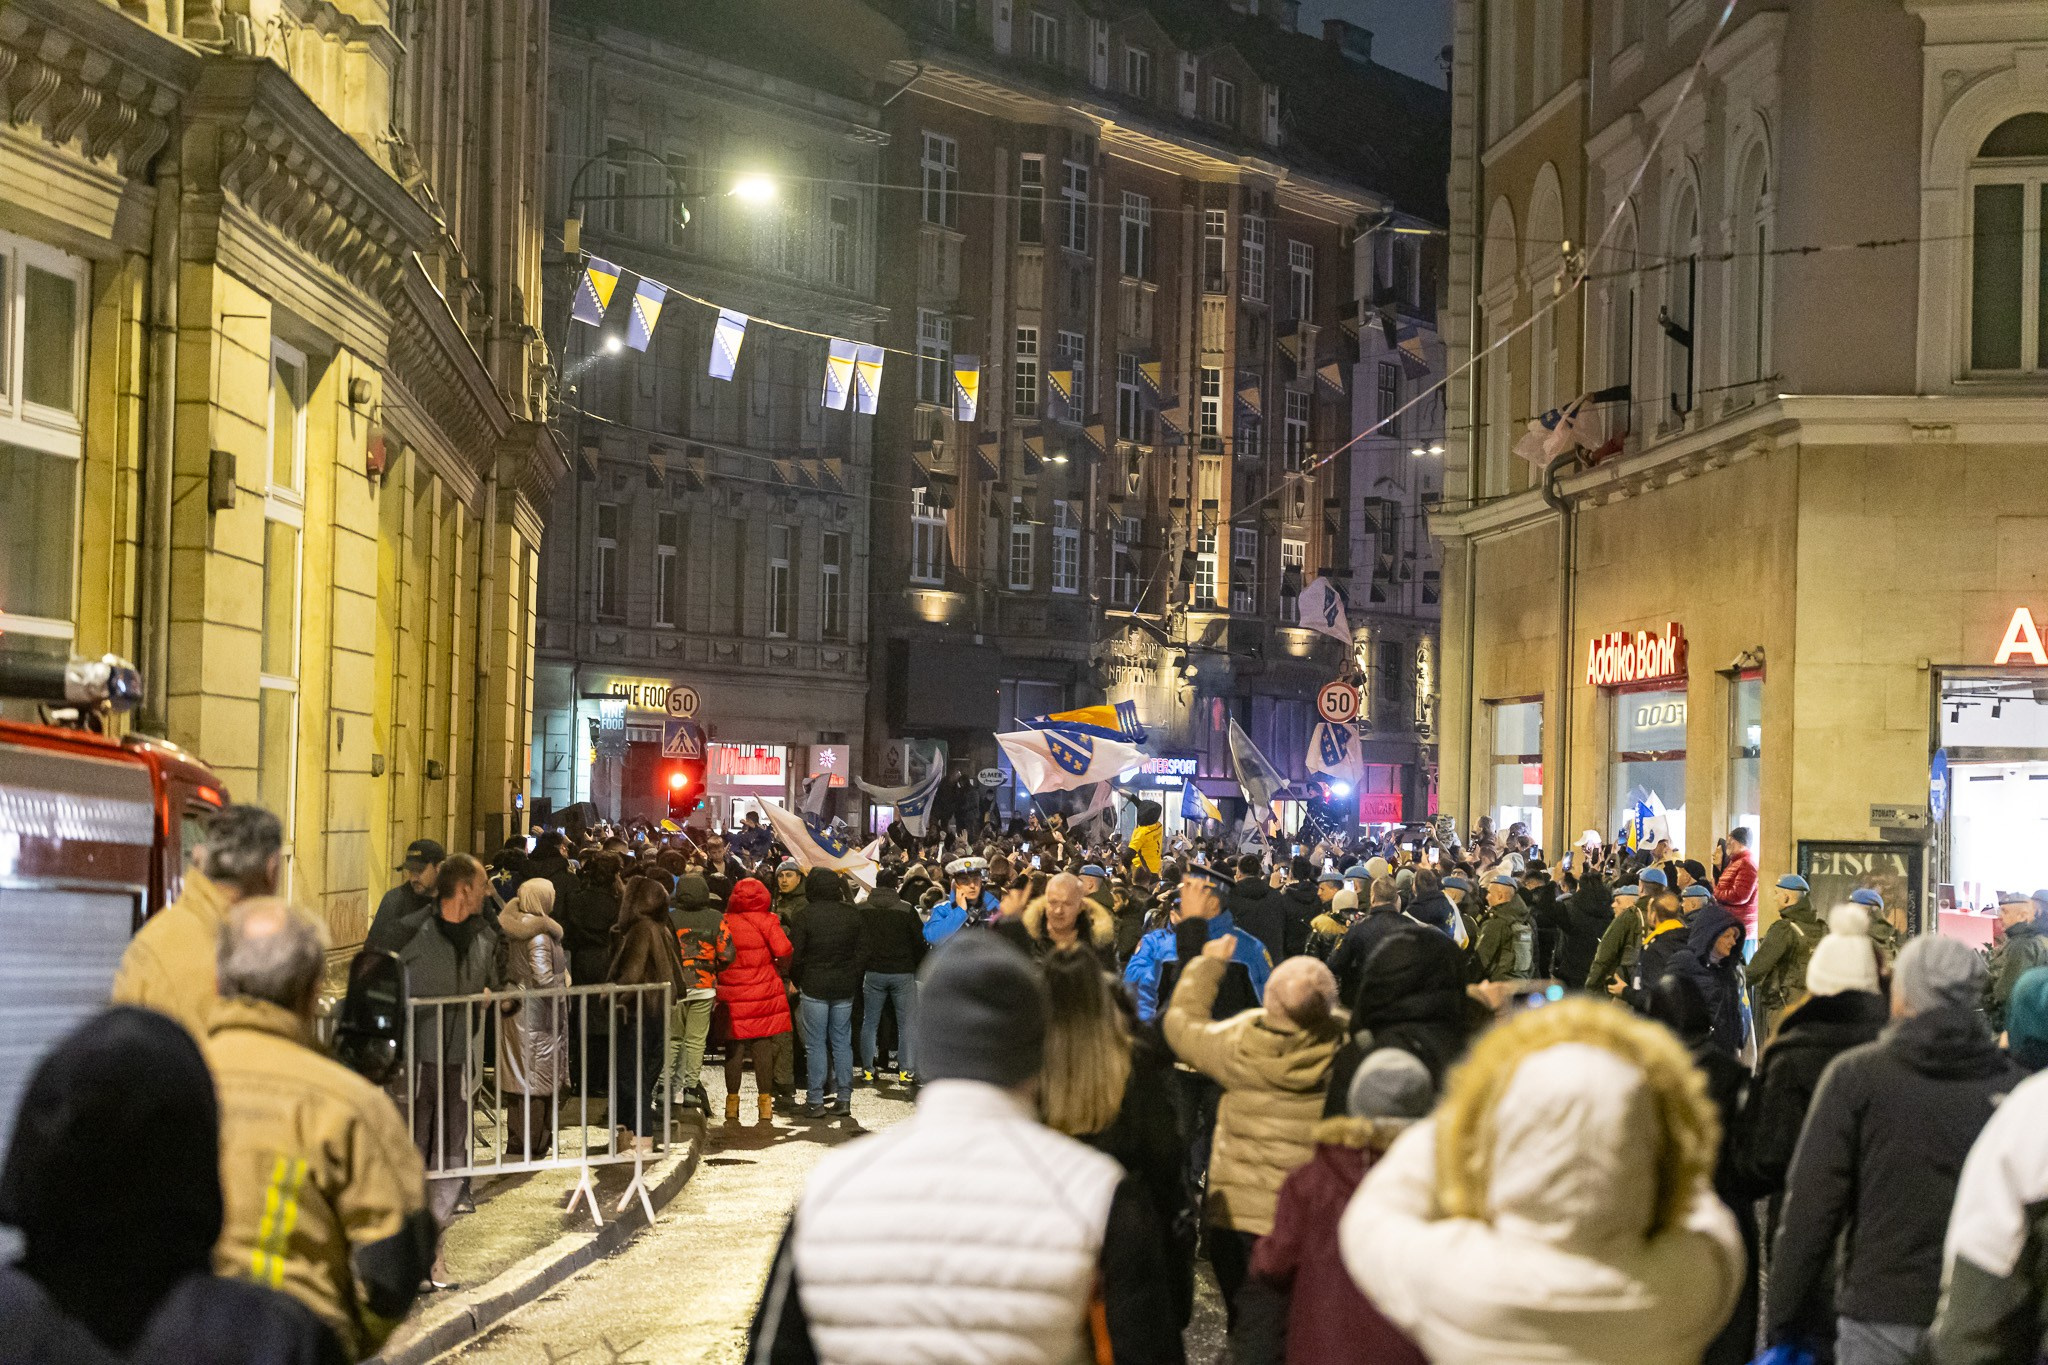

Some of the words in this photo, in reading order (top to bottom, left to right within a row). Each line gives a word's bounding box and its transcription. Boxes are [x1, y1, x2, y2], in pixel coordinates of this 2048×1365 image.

[1586, 631, 1635, 684] Addiko
[1636, 621, 1677, 679] Bank
[672, 693, 693, 711] 50
[1326, 692, 1350, 713] 50
[602, 706, 624, 718] FINE
[602, 718, 624, 730] FOOD
